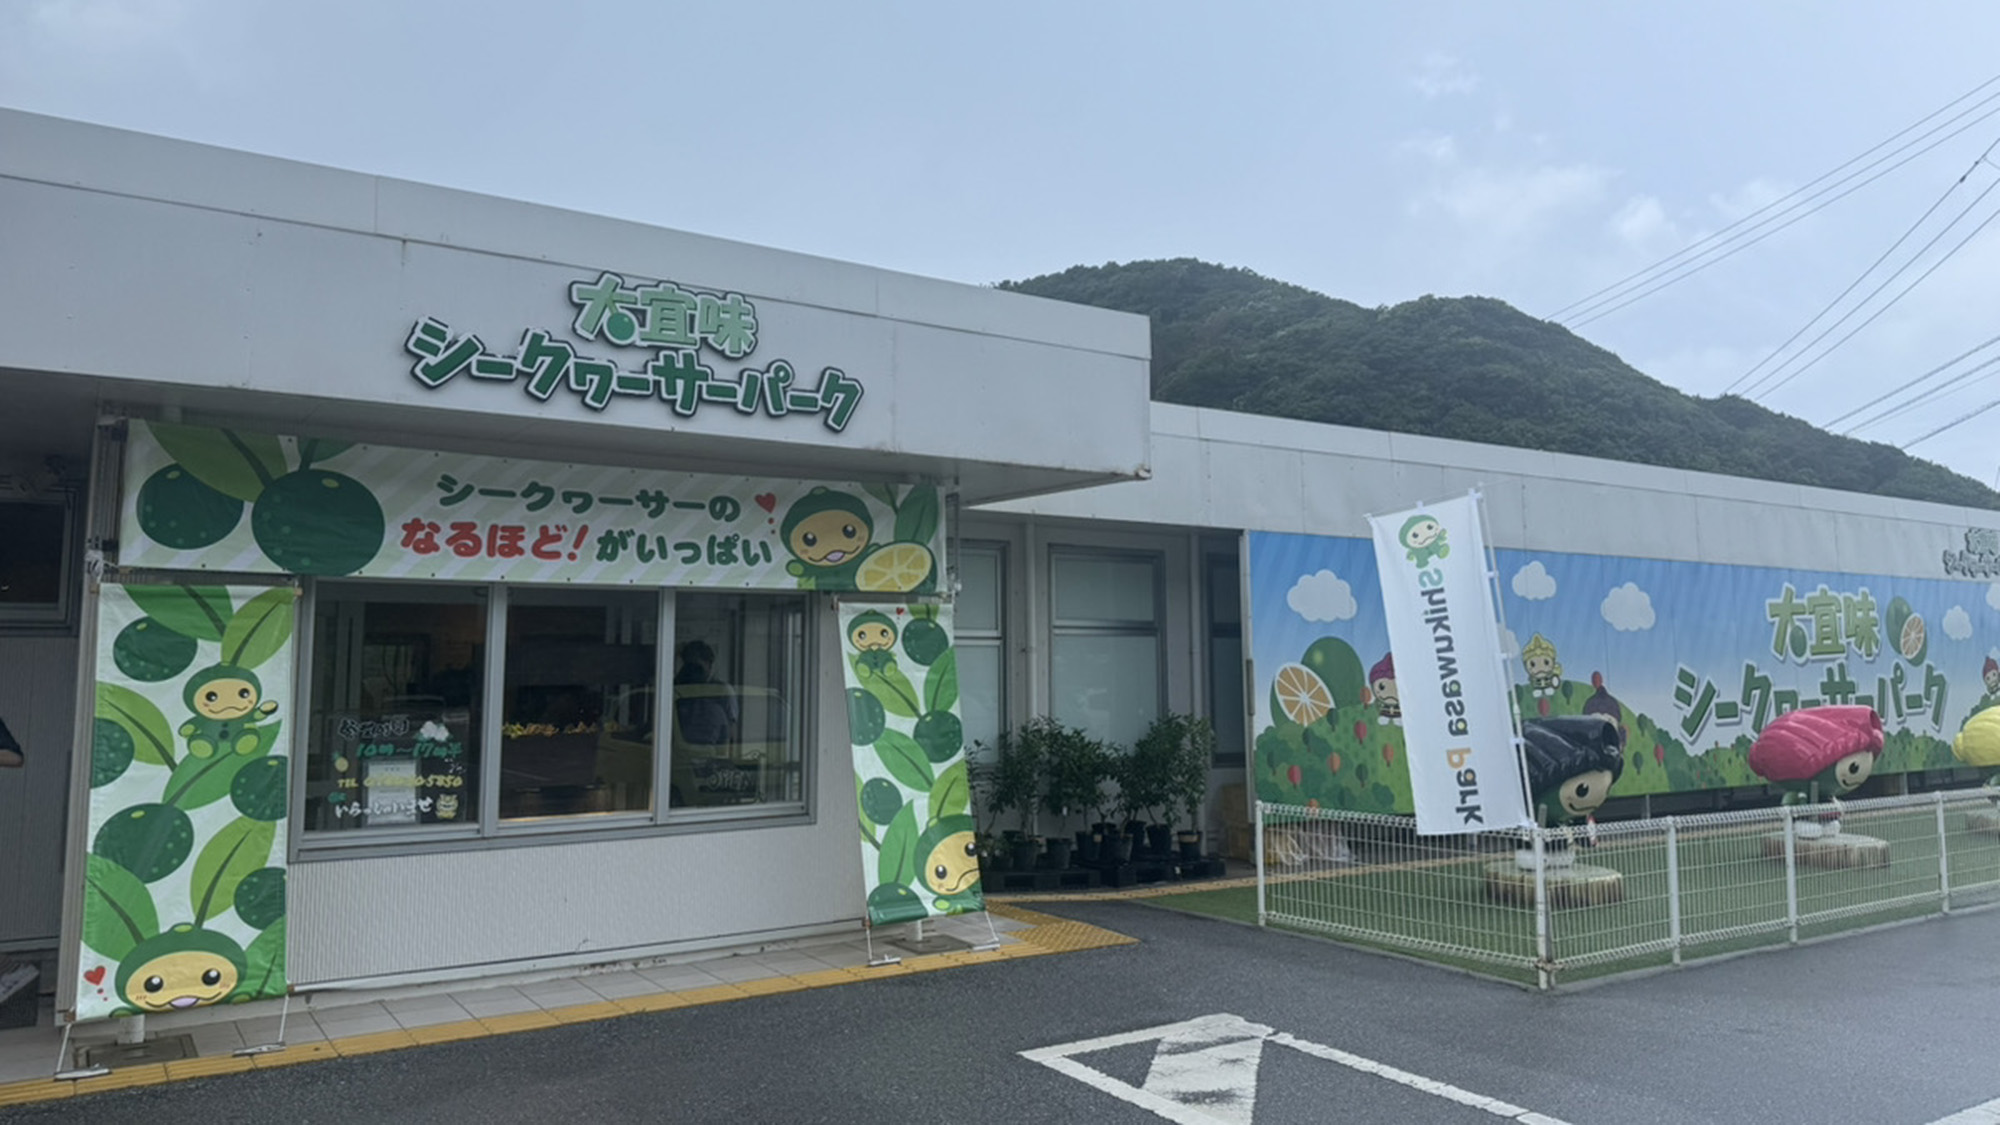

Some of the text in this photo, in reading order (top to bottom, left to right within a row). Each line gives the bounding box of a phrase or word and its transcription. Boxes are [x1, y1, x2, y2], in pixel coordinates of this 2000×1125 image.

[574, 274, 756, 355] 大宜味
[401, 517, 773, 567] なるほど! がいっぱい
[1767, 584, 1881, 660] 大宜味
